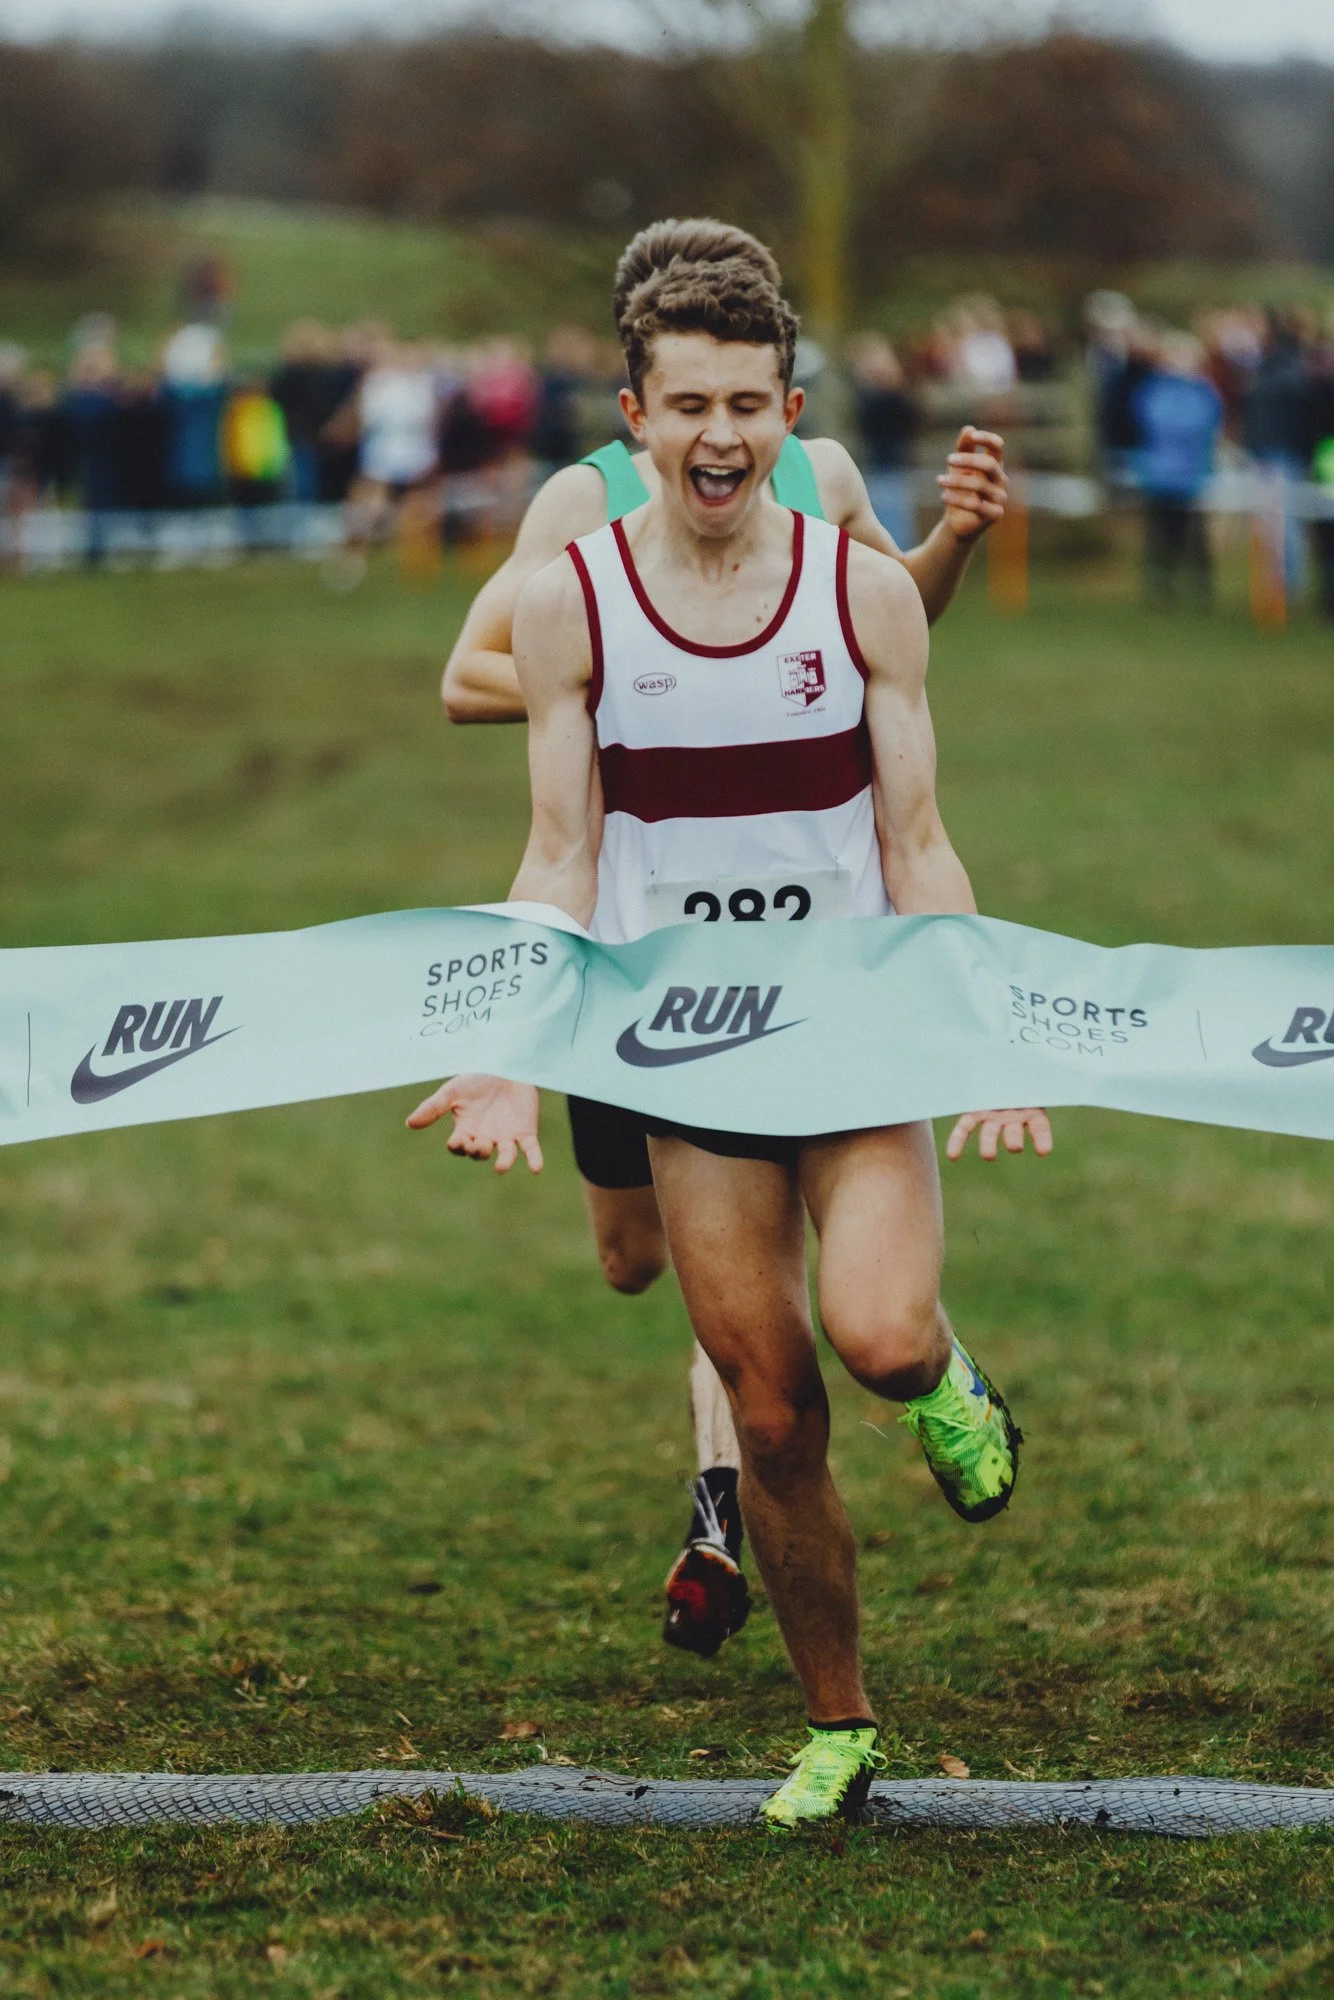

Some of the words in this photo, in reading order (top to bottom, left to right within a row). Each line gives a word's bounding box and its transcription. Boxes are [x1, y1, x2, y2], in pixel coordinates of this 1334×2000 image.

[784, 653, 817, 664] EXETER
[637, 677, 674, 690] wasp
[427, 941, 550, 987] SPORTS
[422, 974, 523, 1018] SHOES
[648, 984, 784, 1035] RUN
[1009, 984, 1148, 1028] SPORTS
[100, 995, 225, 1057] RUN
[1009, 1026, 1104, 1057] .COM
[1011, 1001, 1128, 1043] SHOES
[1281, 1006, 1334, 1044] R
